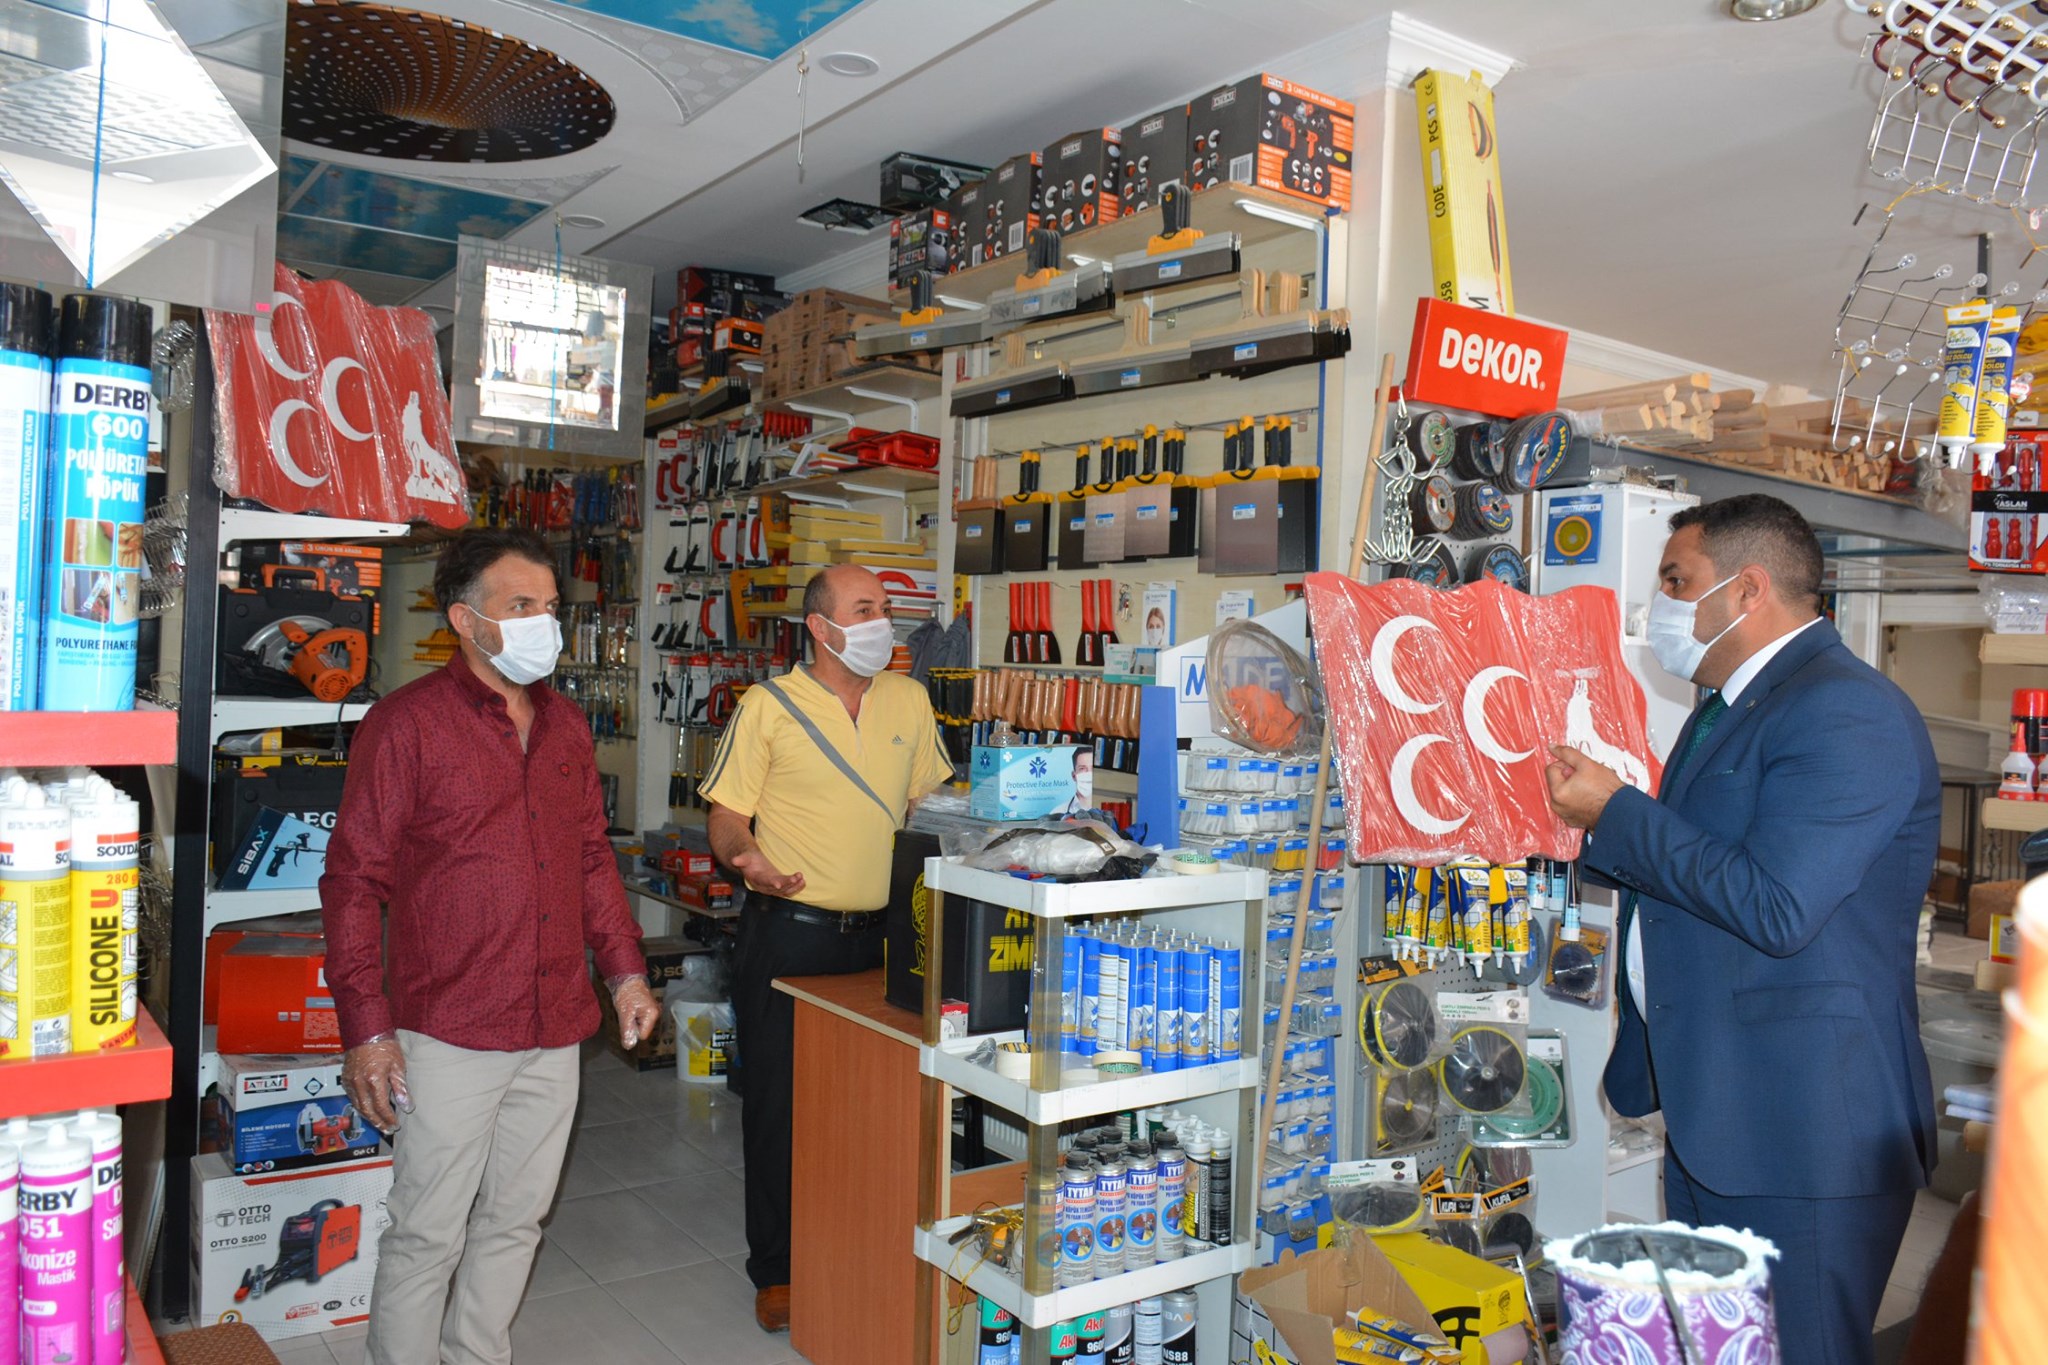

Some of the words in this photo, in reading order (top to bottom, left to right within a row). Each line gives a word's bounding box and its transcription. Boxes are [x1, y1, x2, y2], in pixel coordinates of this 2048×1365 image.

[1428, 119, 1439, 143] PCS
[1433, 185, 1446, 218] CODE
[92, 413, 143, 440] 600
[2000, 500, 2028, 508] ASLAN
[1006, 781, 1037, 789] Protective
[1053, 779, 1069, 787] Mask
[106, 873, 129, 885] 280
[90, 888, 119, 909] U
[90, 916, 118, 1026] SILICONE
[1441, 1201, 1457, 1213] KUPA
[1491, 1193, 1511, 1208] KUPA
[238, 1204, 272, 1217] OTTO
[238, 1213, 271, 1226] TECH
[210, 1237, 239, 1248] OTTO
[241, 1233, 267, 1244] S200
[37, 1271, 77, 1286] Mastik
